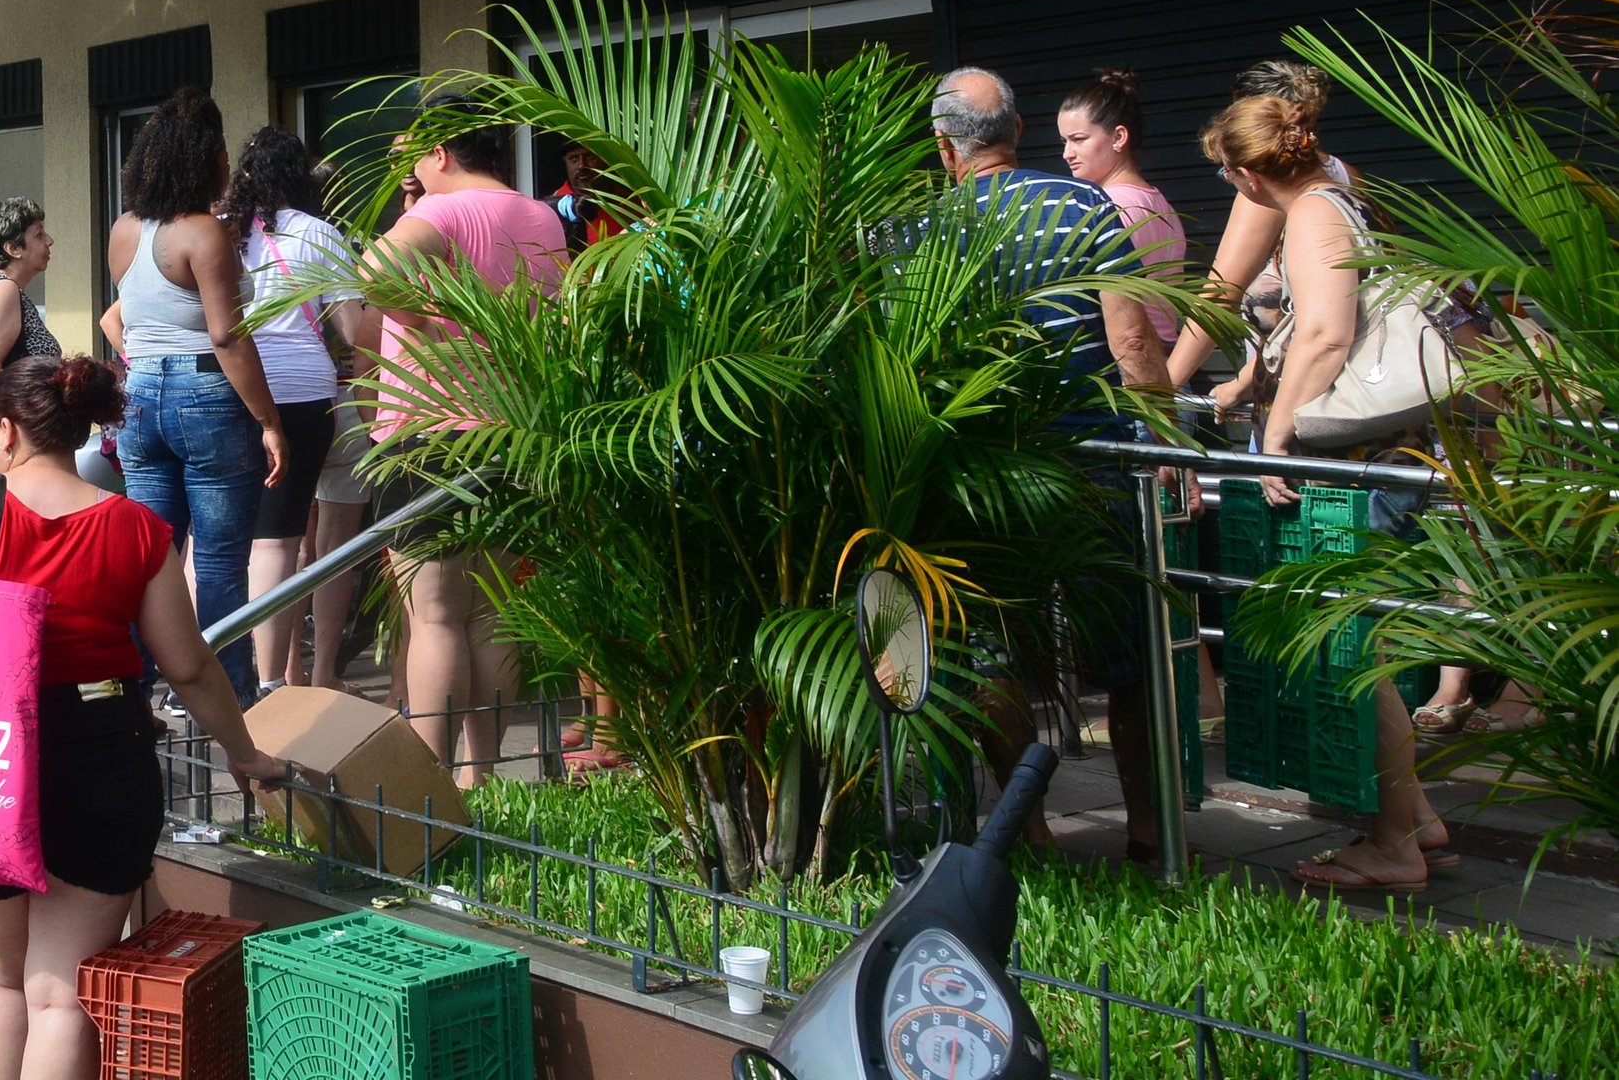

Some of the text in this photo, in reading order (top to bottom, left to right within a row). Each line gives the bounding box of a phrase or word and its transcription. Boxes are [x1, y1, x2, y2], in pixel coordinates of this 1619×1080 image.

[932, 1013, 941, 1026] 100
[957, 1015, 966, 1029] 120
[911, 1020, 920, 1033] 80
[901, 1034, 910, 1046] 60
[905, 1052, 914, 1065] 40
